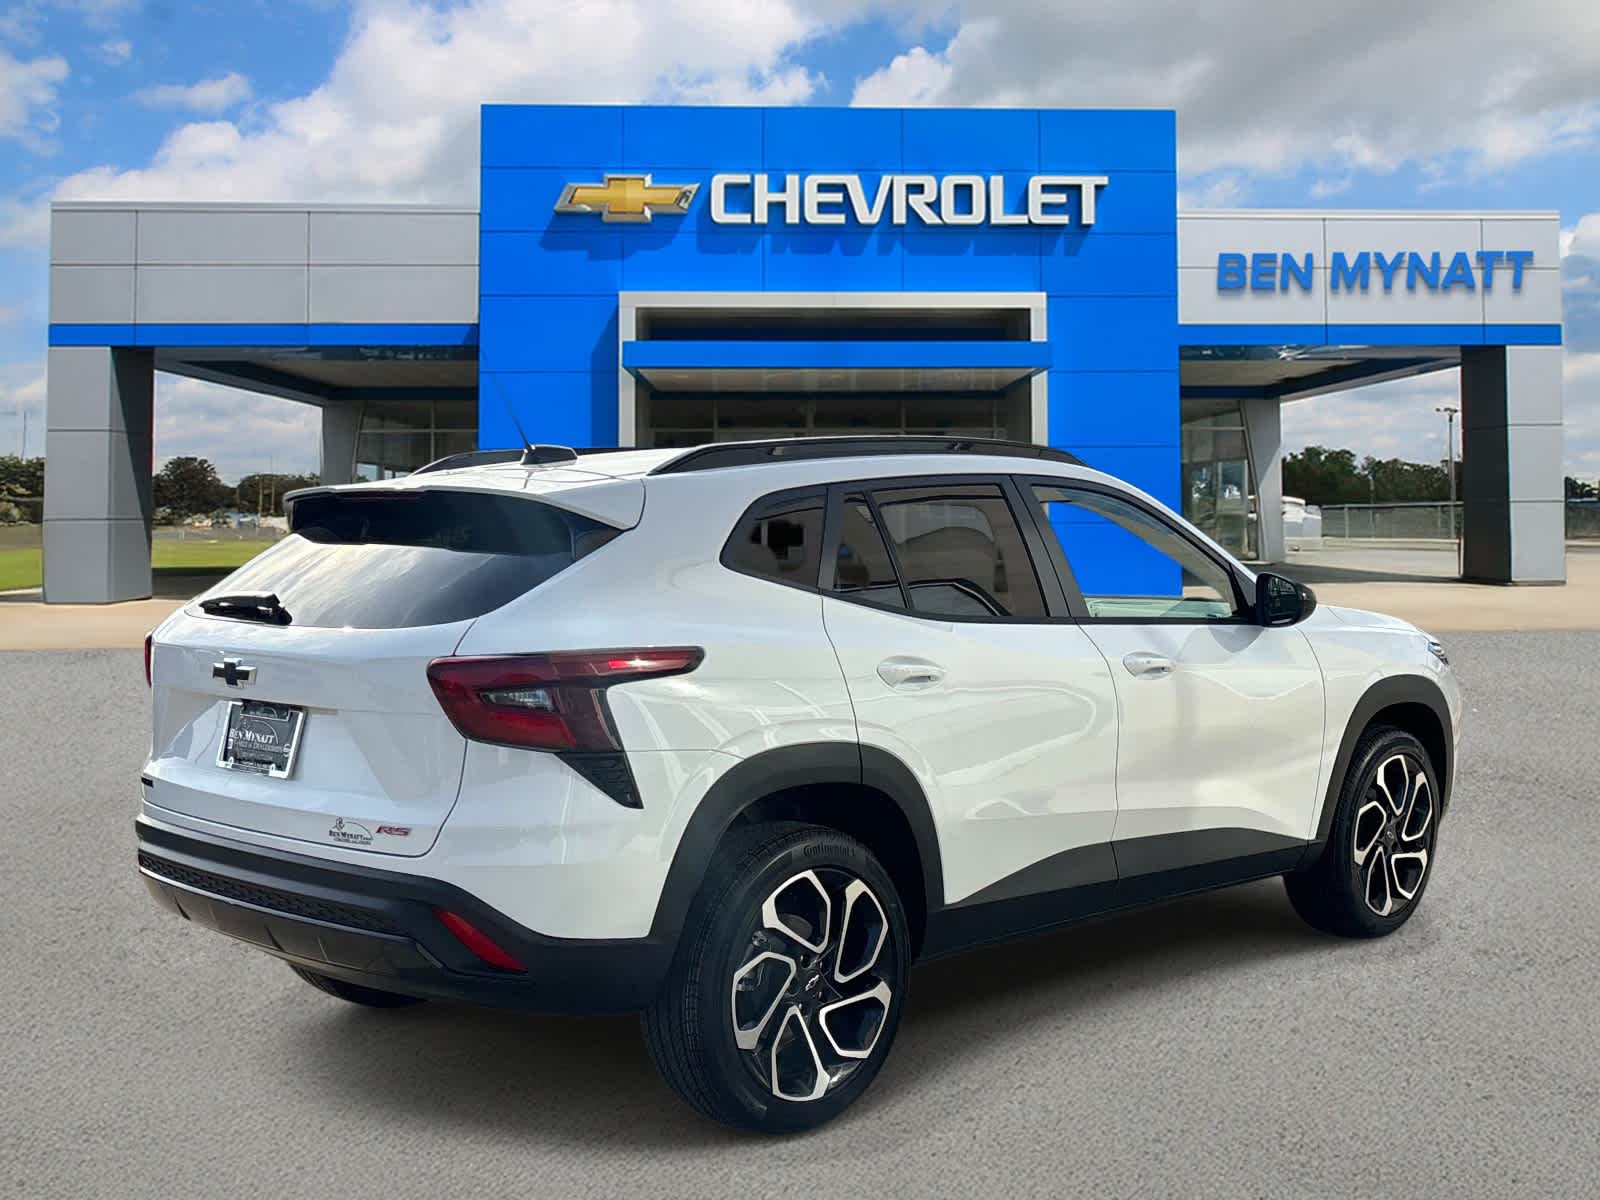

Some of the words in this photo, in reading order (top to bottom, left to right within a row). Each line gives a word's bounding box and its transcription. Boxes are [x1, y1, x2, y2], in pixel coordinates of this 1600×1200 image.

[710, 173, 1109, 225] CHEVROLET
[1217, 252, 1313, 290] BEN
[1330, 250, 1534, 290] MYNATT
[376, 825, 412, 836] RS
